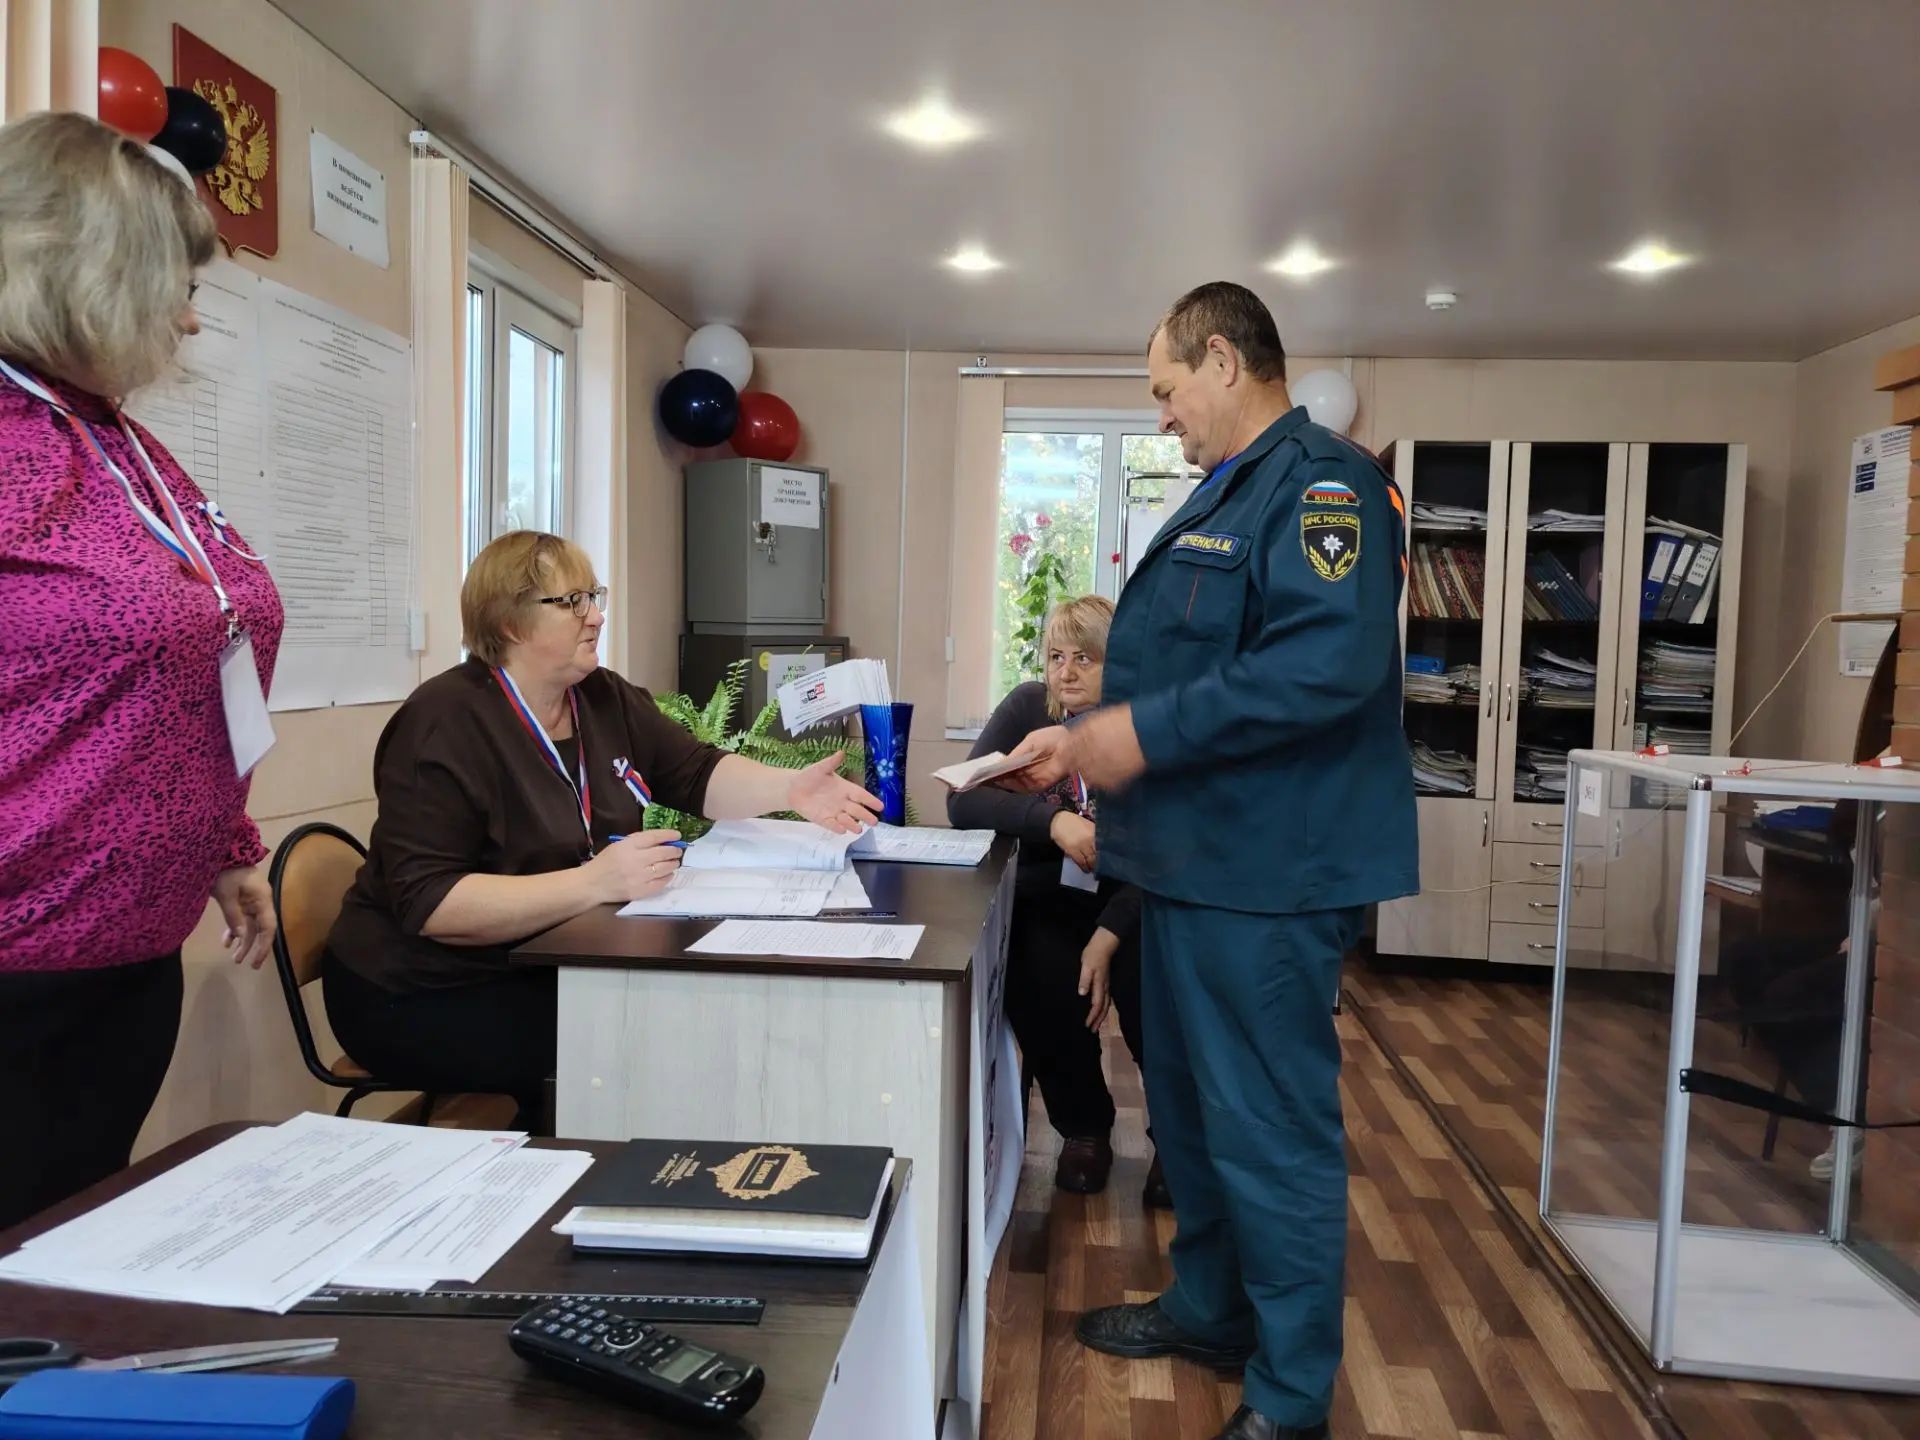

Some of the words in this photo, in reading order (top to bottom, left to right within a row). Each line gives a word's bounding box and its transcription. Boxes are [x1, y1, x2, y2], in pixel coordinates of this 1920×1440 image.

[782, 479, 803, 487] МЕСТО
[1314, 495, 1348, 503] RUSSIA
[1304, 515, 1322, 526] МЧС
[1323, 515, 1357, 526] РОССИИ
